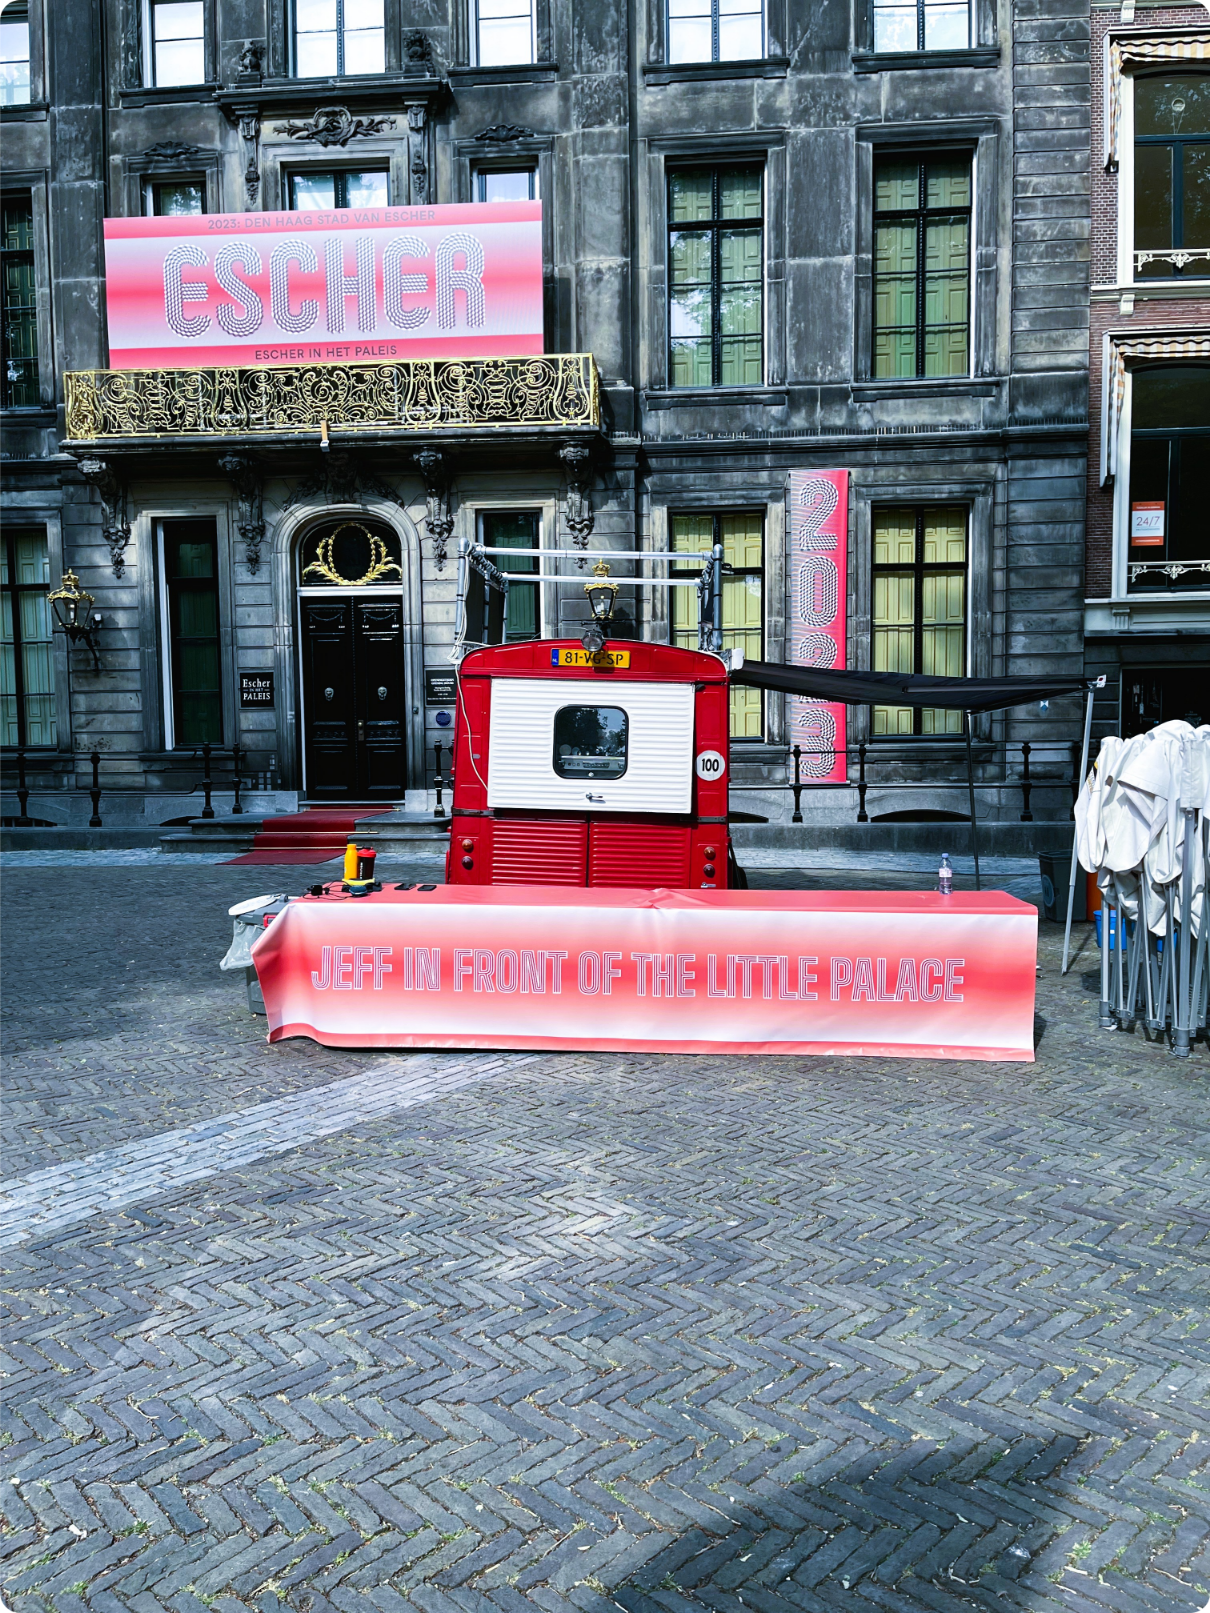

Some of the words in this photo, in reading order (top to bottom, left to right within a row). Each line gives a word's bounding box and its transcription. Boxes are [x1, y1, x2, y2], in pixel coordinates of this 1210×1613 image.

[208, 219, 240, 230] 2023:
[245, 217, 271, 228] DEN
[276, 216, 313, 226] HAAG
[317, 213, 349, 225] STAD
[354, 212, 380, 223] VAN
[385, 210, 435, 222] ESCHER
[163, 232, 486, 338] ESCHER
[255, 348, 304, 360] ESCHER
[309, 348, 321, 358] IN
[326, 346, 350, 357] HET
[355, 345, 397, 356] PALEIS
[1136, 515, 1161, 527] 24/7
[564, 651, 624, 665] 81-VG-SP
[242, 677, 271, 688] Escher
[242, 692, 271, 700] PALEIS
[701, 758, 720, 772] 100
[311, 945, 393, 990] JEFF
[403, 947, 441, 991] IN
[453, 948, 568, 994] FRONT
[577, 950, 622, 995] OF
[631, 952, 696, 998] THE
[707, 953, 818, 1001] LITTLE
[830, 957, 965, 1002] PALACE
